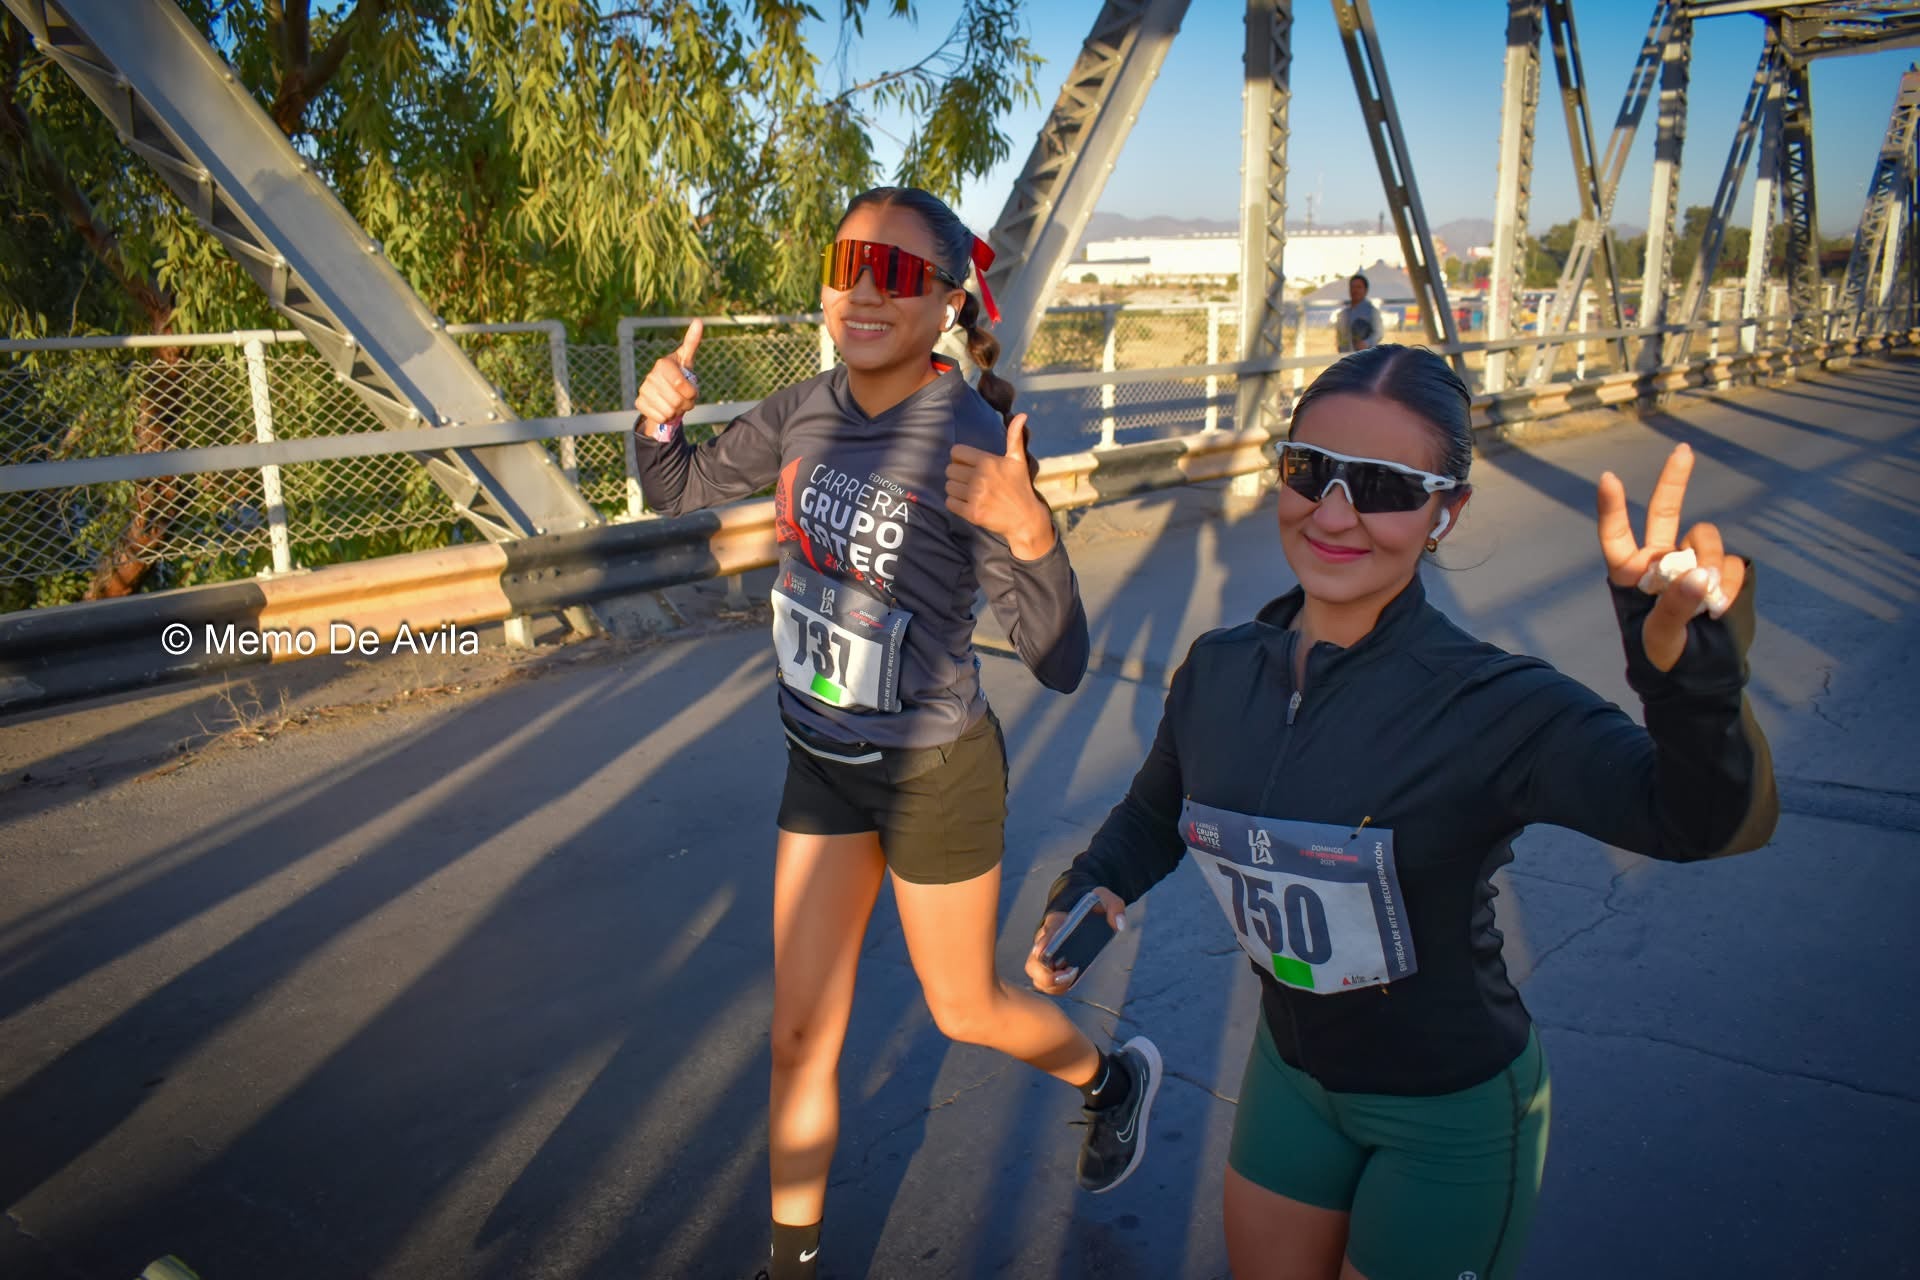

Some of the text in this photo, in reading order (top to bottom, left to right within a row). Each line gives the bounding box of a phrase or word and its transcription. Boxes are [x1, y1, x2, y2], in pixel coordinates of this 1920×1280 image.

[800, 486, 905, 550] GRUPO
[810, 463, 909, 523] CARRERA
[790, 608, 851, 689] 737
[1196, 827, 1219, 840] GRUPO
[1311, 844, 1344, 855] DOMINGO
[1216, 861, 1333, 965] 750
[1373, 841, 1408, 972] ENTREGA DE KIT DE RECUPERACIÓN
